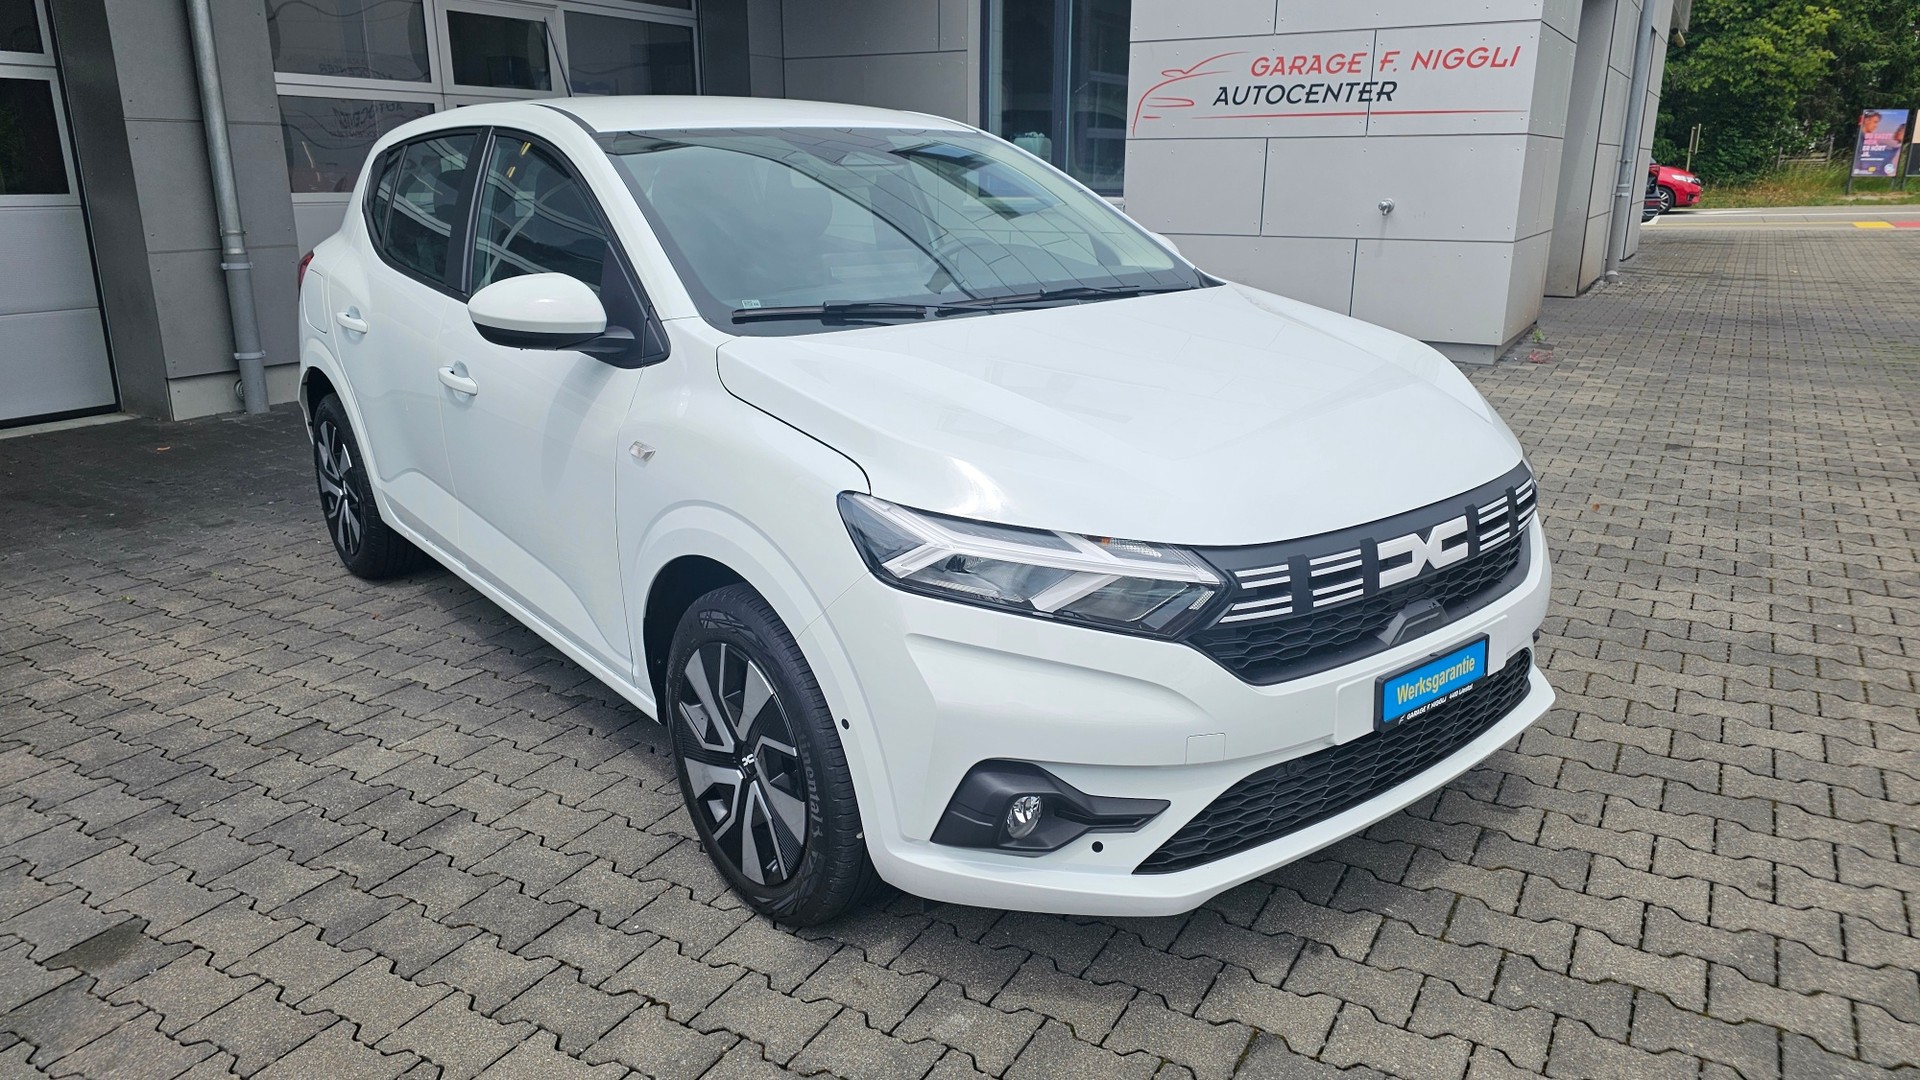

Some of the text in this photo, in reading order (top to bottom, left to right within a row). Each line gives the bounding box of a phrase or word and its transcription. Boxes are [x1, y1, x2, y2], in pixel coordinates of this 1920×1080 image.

[1250, 45, 1521, 77] GARAGE F. NIGGLI
[1213, 81, 1398, 107] AUTOCENTER
[1397, 655, 1475, 705] Werksgarantie
[1406, 704, 1427, 720] GARAGE
